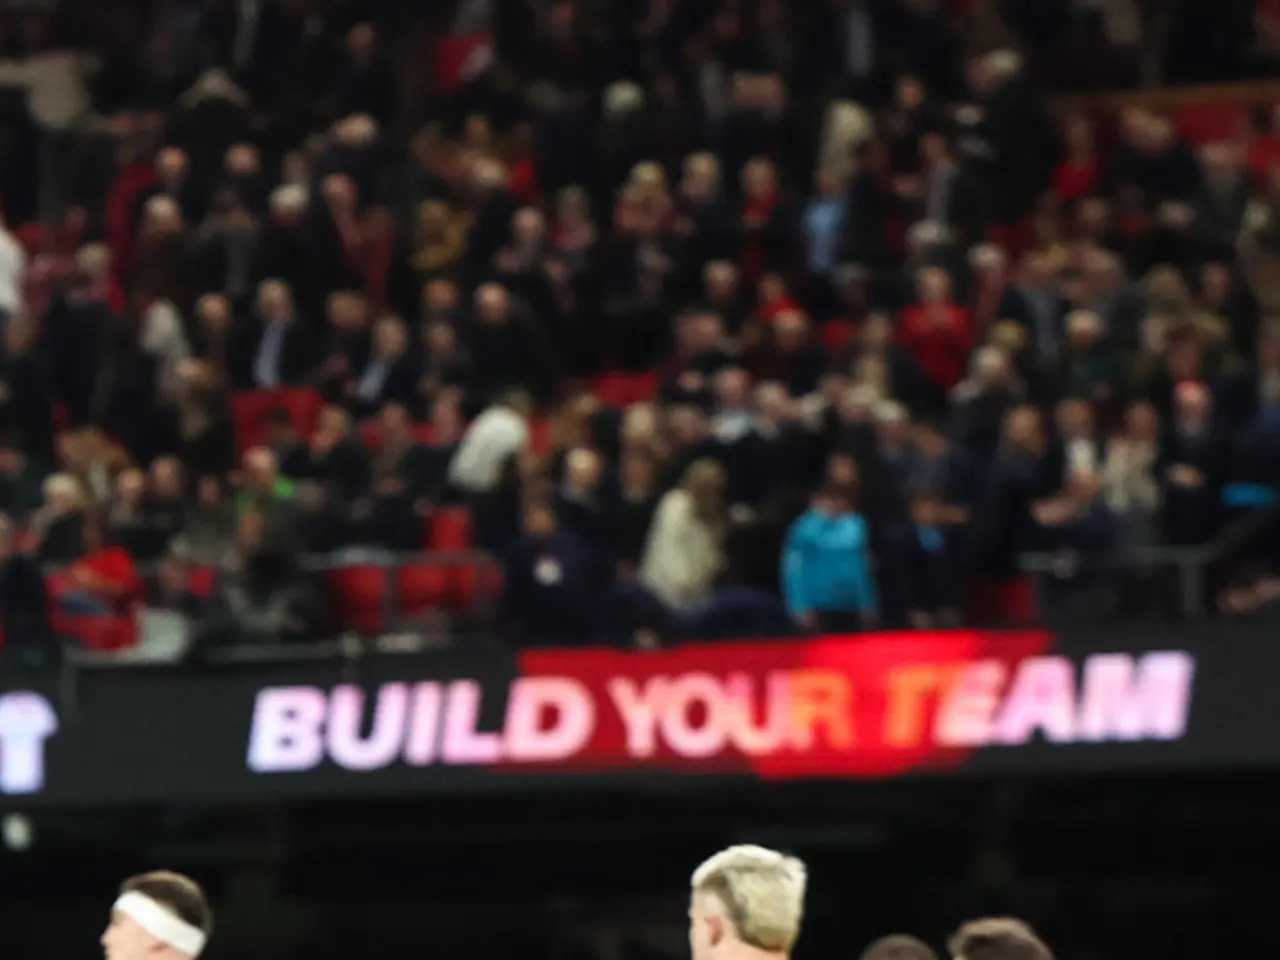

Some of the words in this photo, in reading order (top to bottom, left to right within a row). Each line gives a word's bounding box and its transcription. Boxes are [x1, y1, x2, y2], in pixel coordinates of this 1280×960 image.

[246, 677, 596, 773] BUILD
[608, 670, 853, 757] YOUR
[882, 650, 1195, 746] TEAM
